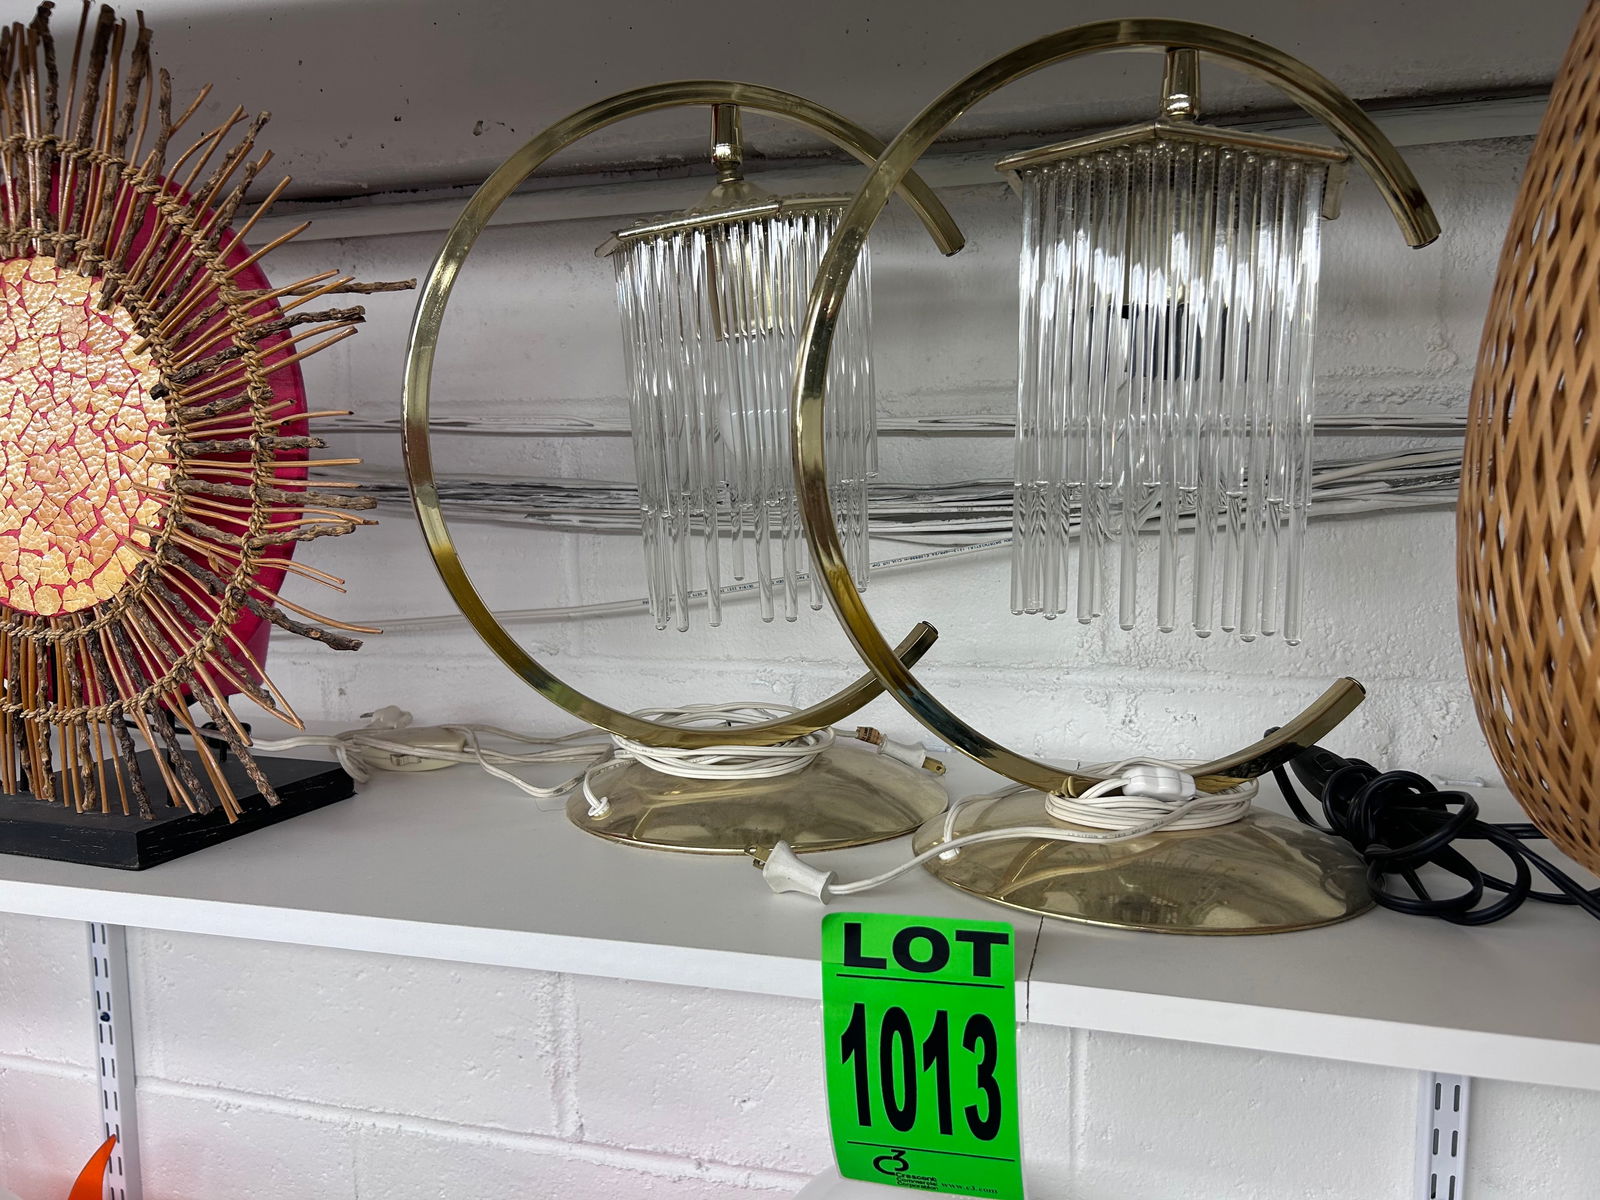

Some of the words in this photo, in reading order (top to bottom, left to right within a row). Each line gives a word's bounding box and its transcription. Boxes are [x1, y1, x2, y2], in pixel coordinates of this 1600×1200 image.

[843, 922, 1009, 978] LOT
[840, 1002, 1002, 1141] 1013
[895, 1172, 937, 1182] Crescent
[941, 1182, 998, 1194] www.c3.com
